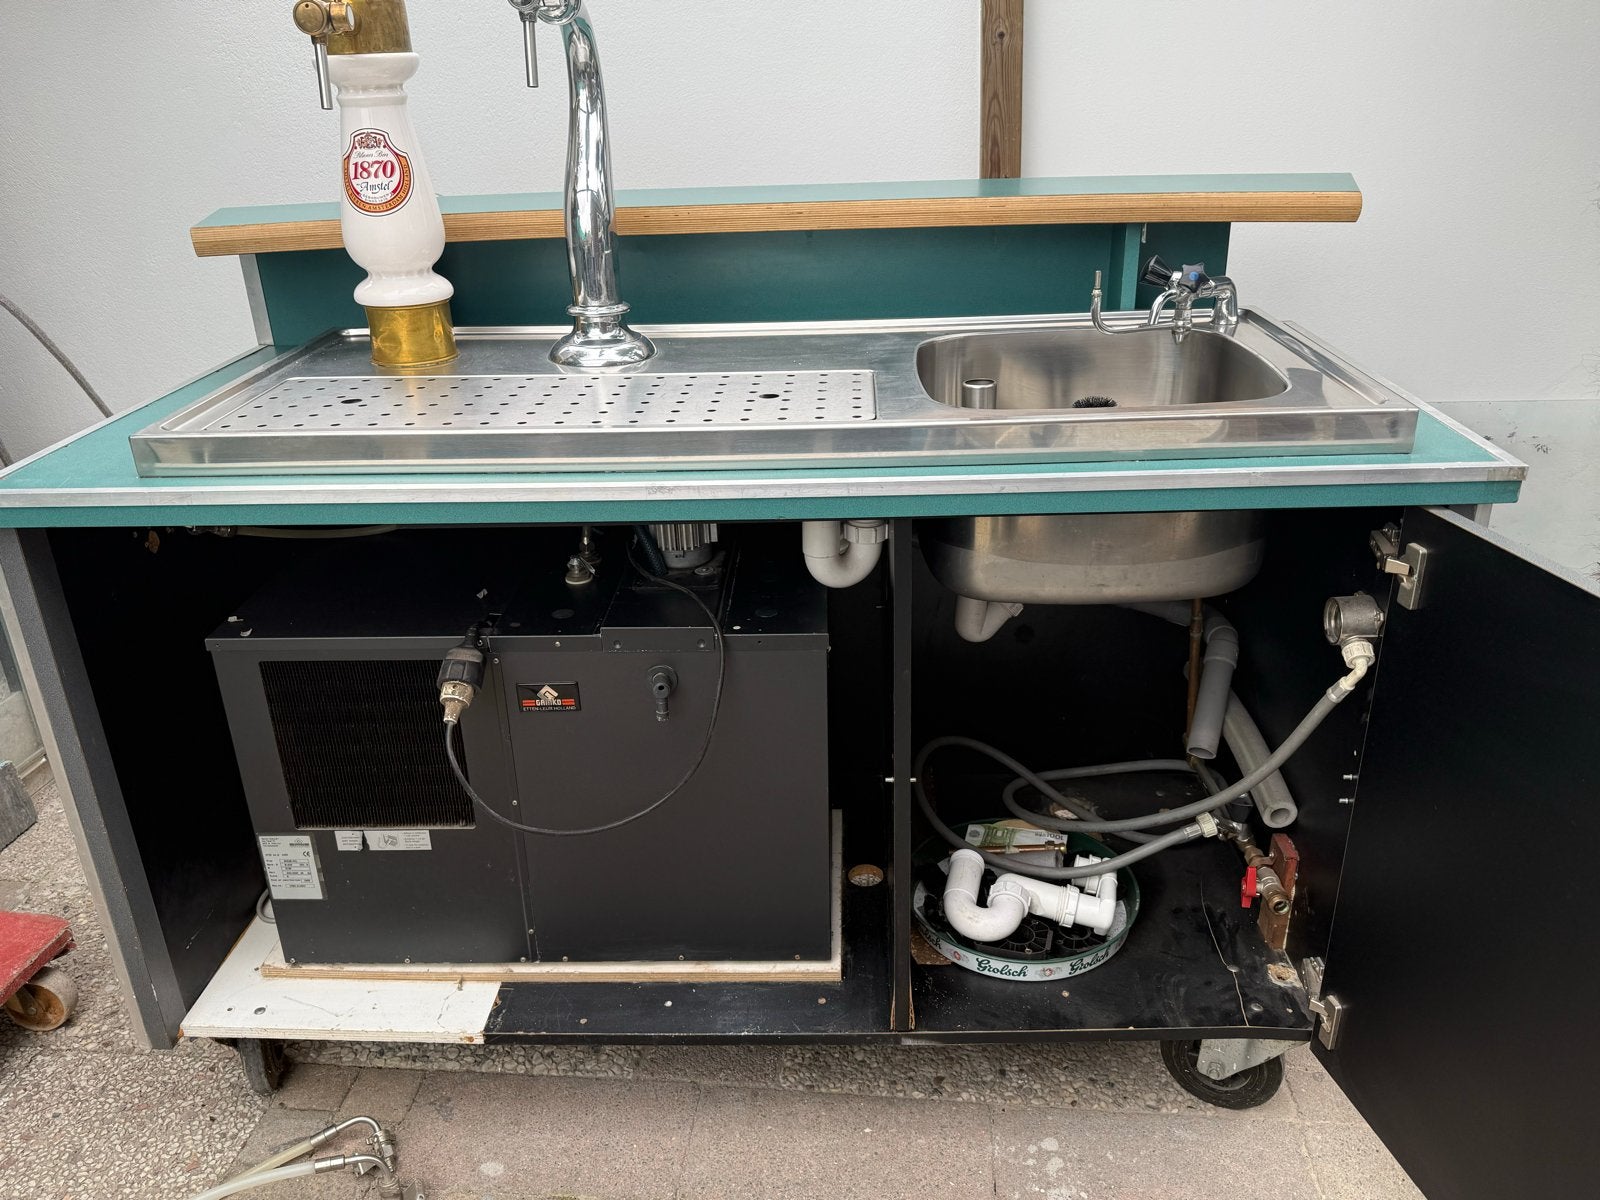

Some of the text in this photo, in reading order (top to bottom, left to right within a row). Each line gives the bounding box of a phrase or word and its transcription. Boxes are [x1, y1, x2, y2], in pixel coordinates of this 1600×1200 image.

[352, 160, 396, 180] 1870
[356, 180, 393, 194] Amstel
[975, 957, 1029, 977] Grolsch
[1069, 945, 1111, 975] Grolsch
